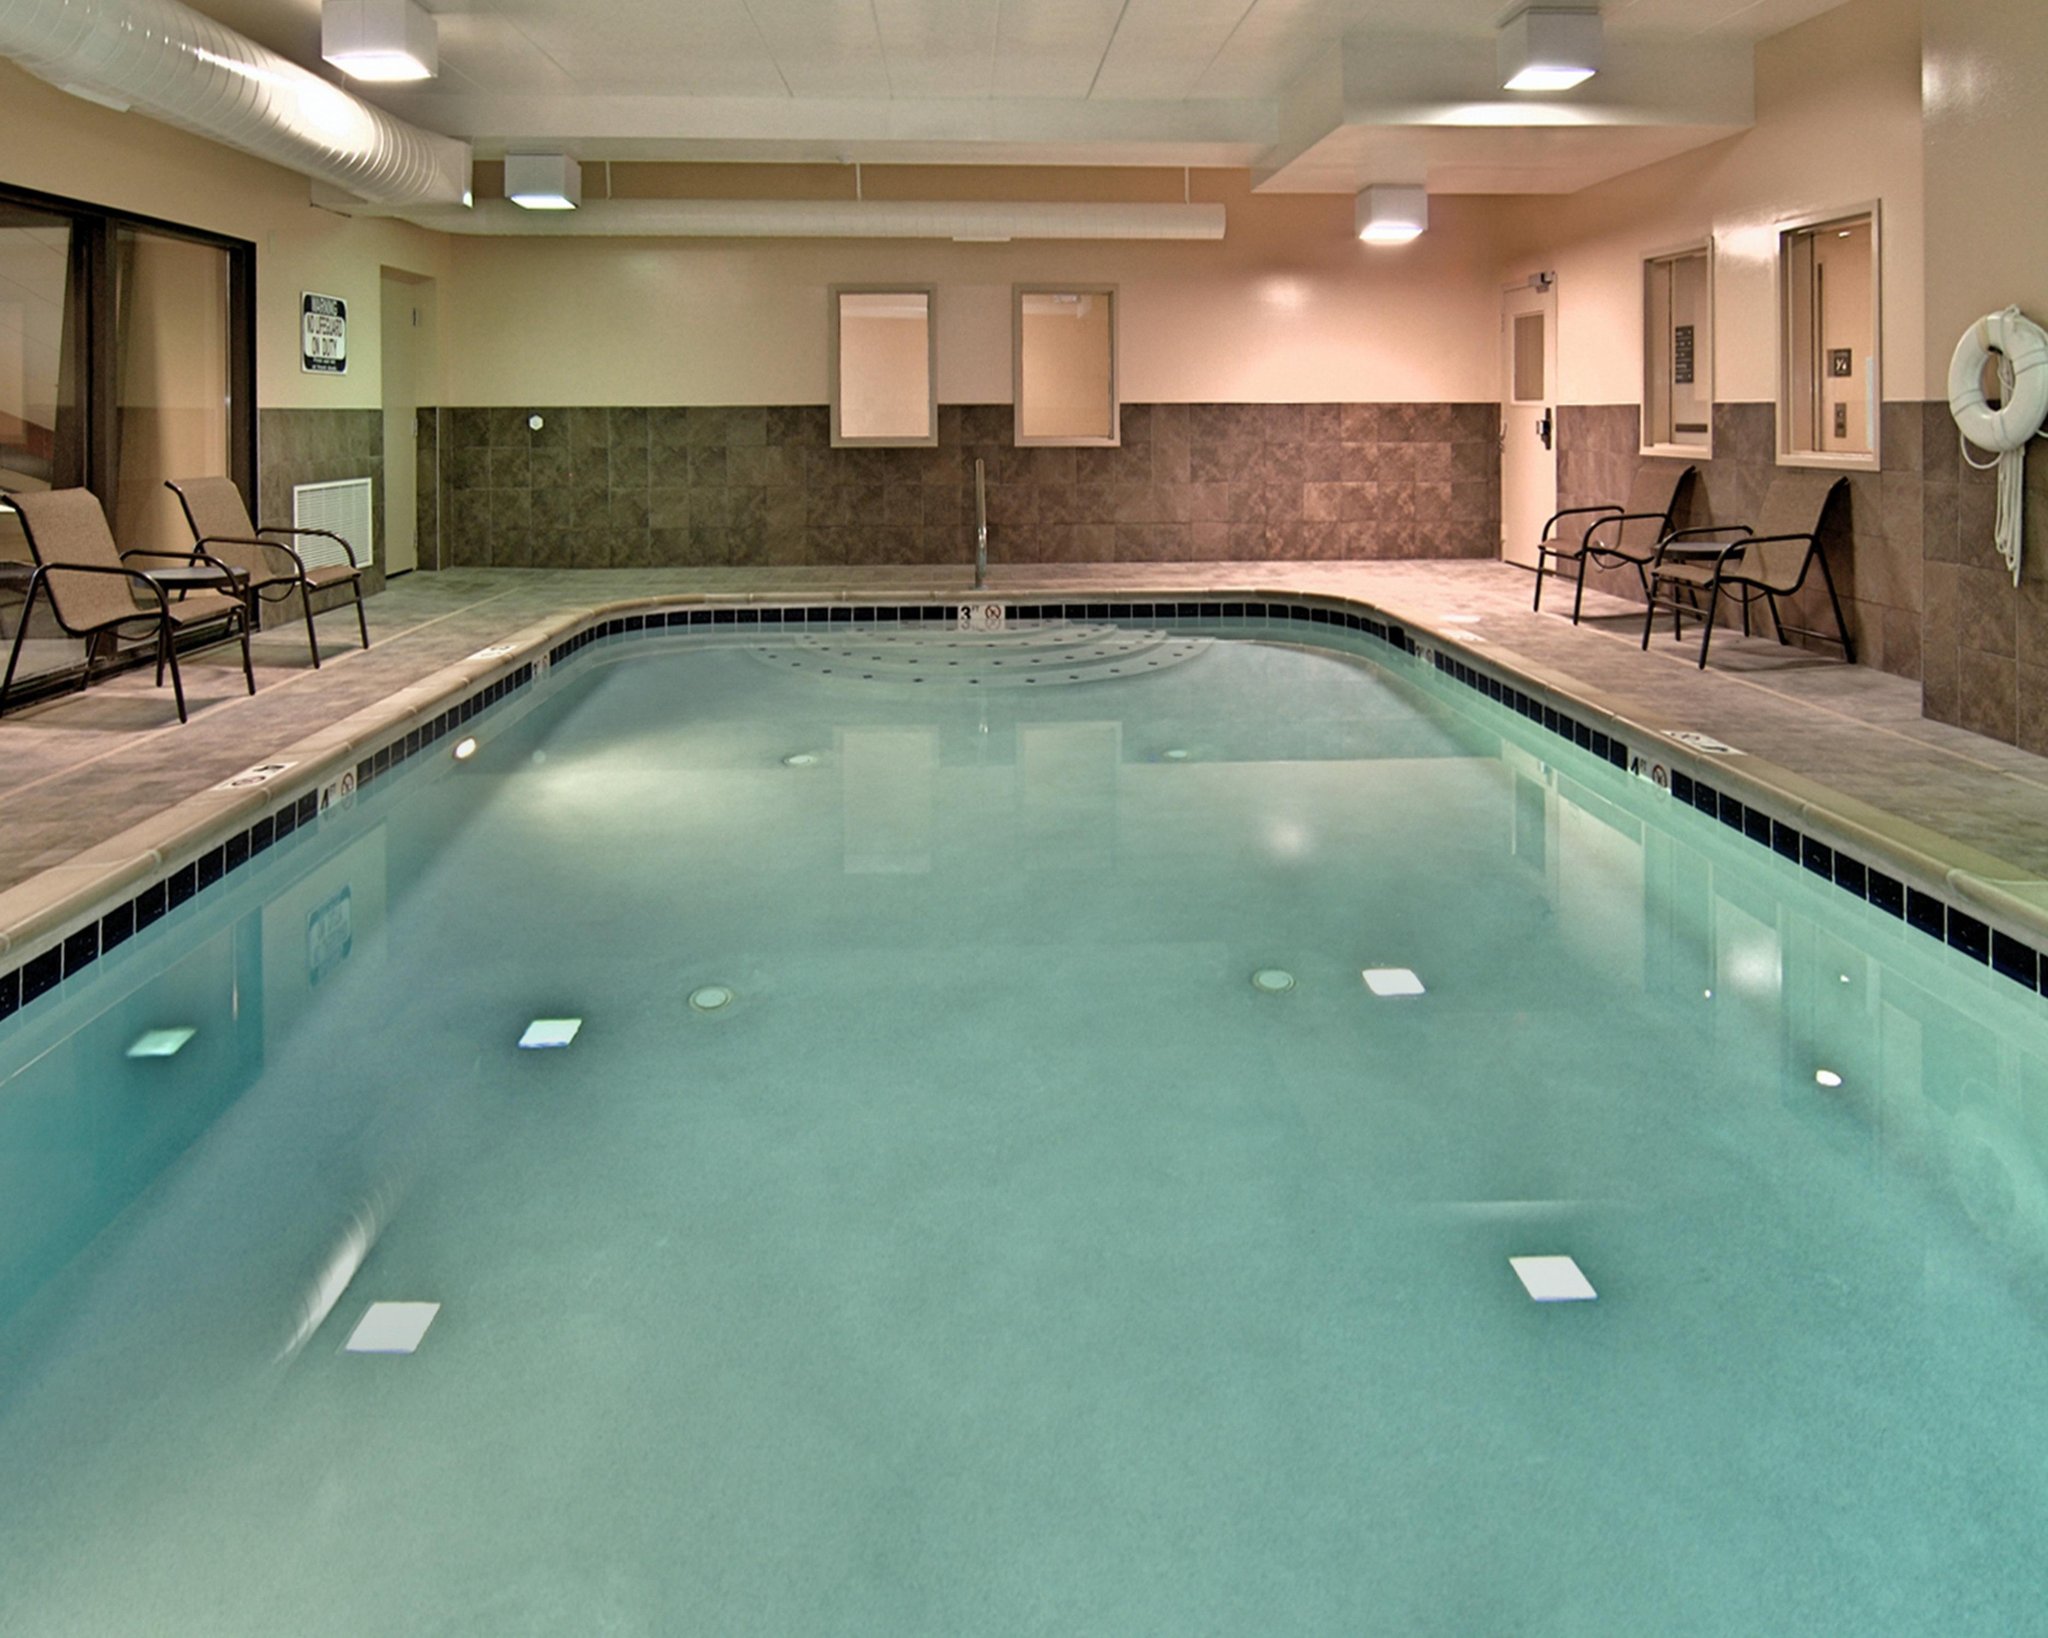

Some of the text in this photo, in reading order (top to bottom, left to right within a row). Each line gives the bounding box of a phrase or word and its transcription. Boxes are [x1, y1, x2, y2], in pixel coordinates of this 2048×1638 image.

[311, 297, 338, 316] WARNING
[316, 315, 342, 337] LIFEGUARD
[311, 337, 337, 356] ON DUTY
